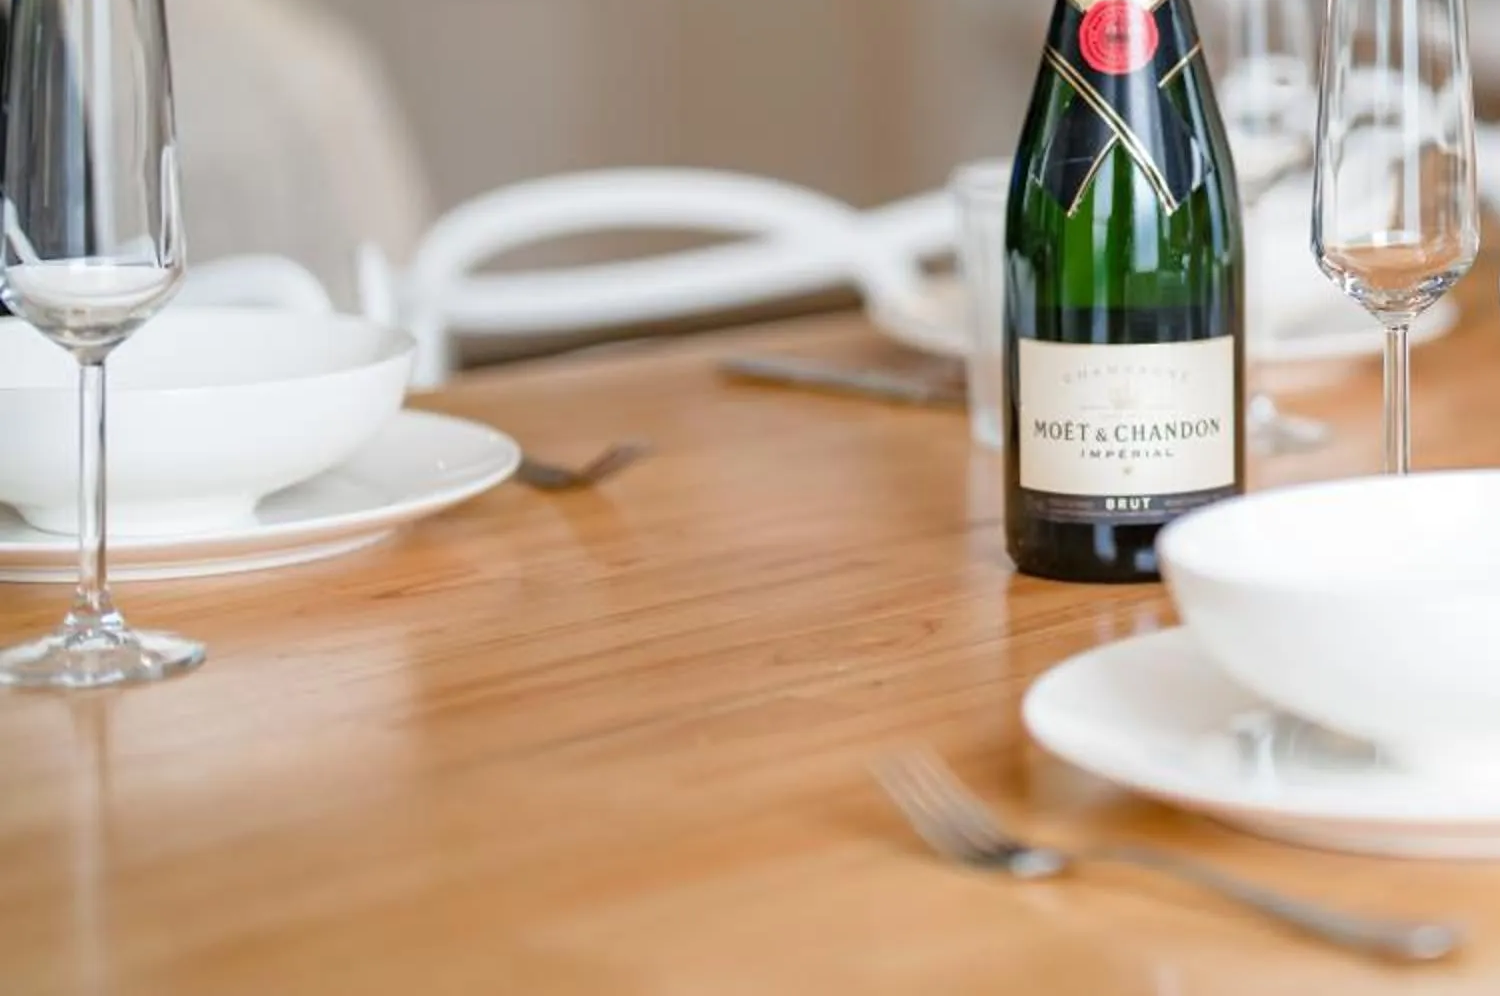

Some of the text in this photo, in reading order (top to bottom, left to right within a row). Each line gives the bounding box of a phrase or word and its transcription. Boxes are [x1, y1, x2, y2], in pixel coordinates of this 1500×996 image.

[1095, 427, 1107, 442] &
[1114, 418, 1220, 443] CHANDON
[1105, 497, 1151, 511] BRUT
